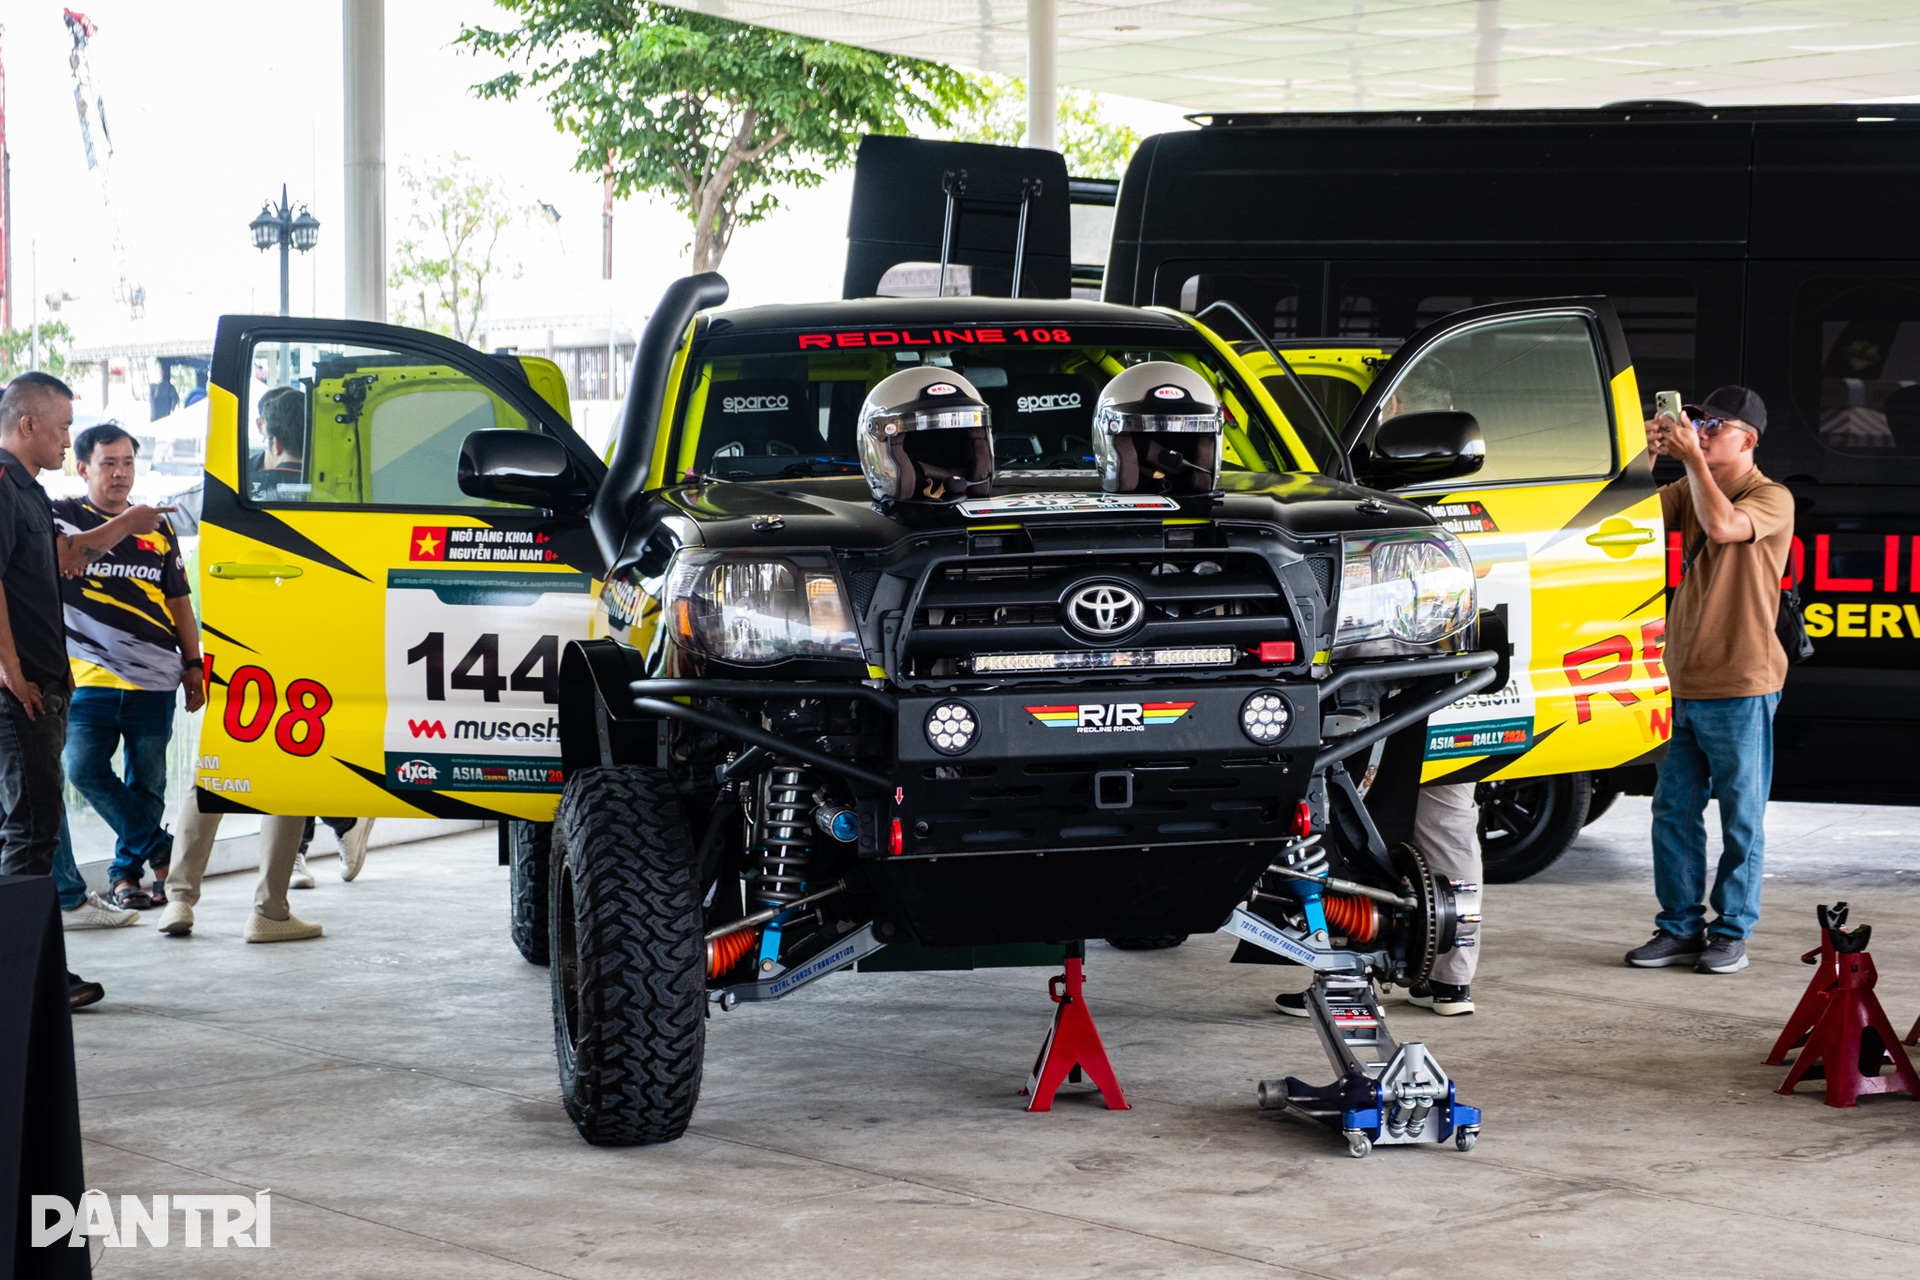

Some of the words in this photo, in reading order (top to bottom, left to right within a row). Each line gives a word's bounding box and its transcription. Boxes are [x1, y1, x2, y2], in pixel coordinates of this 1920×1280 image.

[798, 329, 1006, 349] REDLINE
[1013, 328, 1072, 343] 108
[723, 395, 789, 414] sparco
[1017, 392, 1082, 413] sparco
[1446, 504, 1470, 516] KHOA
[451, 528, 473, 543] NGÔ
[475, 528, 503, 543] ĐĂNG
[505, 531, 534, 544] KHOA
[535, 532, 550, 544] A+
[449, 543, 491, 560] NGUYỄN
[493, 546, 518, 561] HOÀI
[520, 548, 543, 561] NAM
[407, 631, 560, 705] 144
[1078, 703, 1143, 727] R/R
[454, 717, 562, 743] musash
[1429, 735, 1455, 751] ASIA
[1473, 730, 1504, 747] RALLY
[1503, 729, 1527, 744] 2026
[200, 777, 251, 793] TEAM
[452, 766, 483, 781] ASIA
[508, 768, 548, 783] RALLY
[547, 770, 564, 783] 20
[1240, 919, 1259, 935] TOTAL
[1259, 929, 1279, 944] CHAOS
[1278, 939, 1316, 963] FABRICATION
[769, 979, 791, 995] TOTAL
[791, 968, 812, 984] CHAOS
[813, 945, 855, 973] FABRICATION
